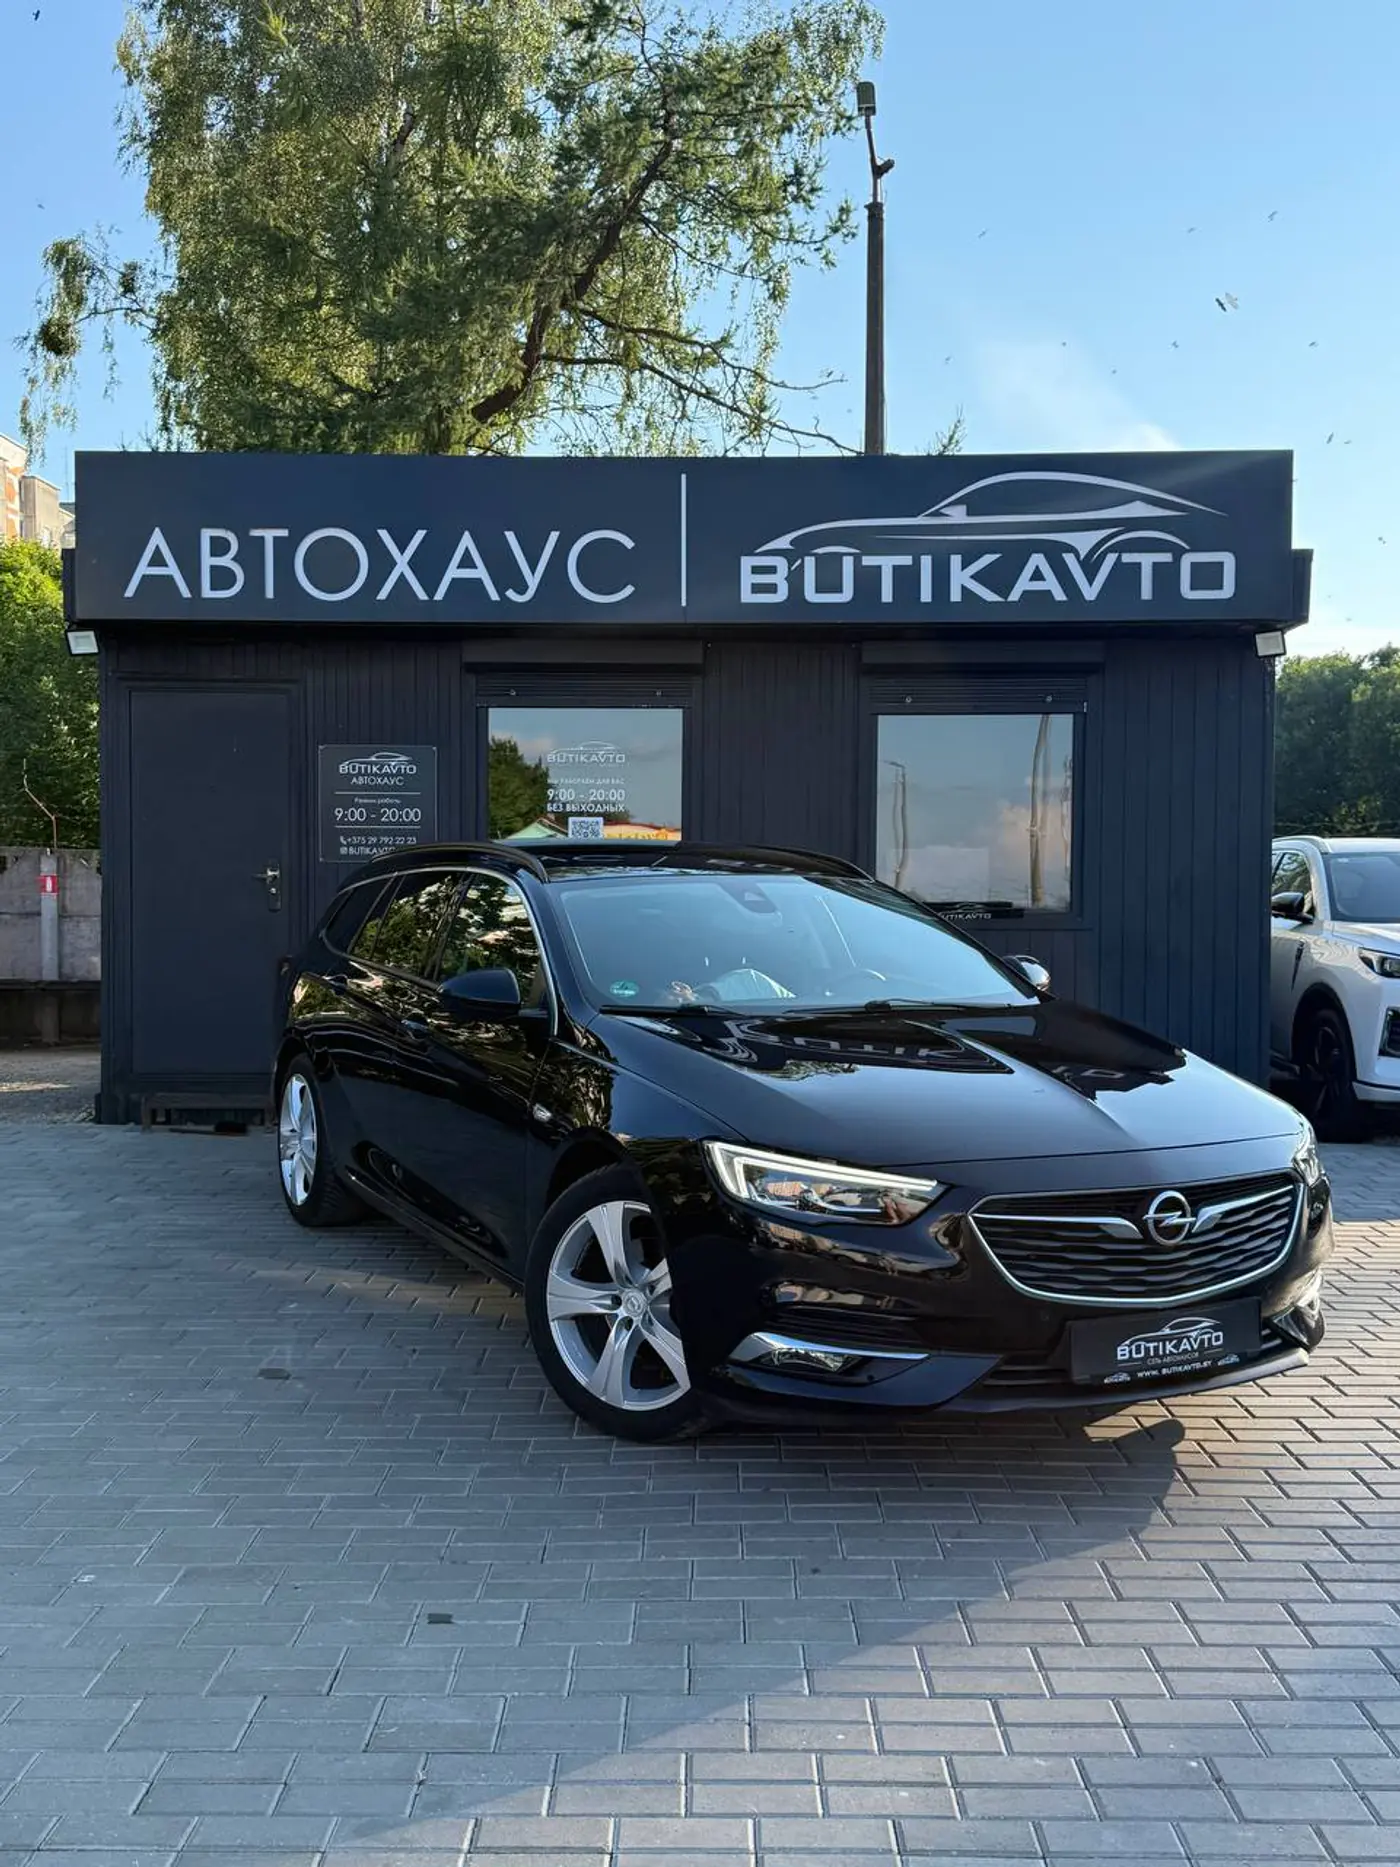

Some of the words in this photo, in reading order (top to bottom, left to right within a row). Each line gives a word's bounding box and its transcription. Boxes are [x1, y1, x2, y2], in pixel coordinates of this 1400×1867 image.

[124, 526, 636, 604] АВТОХАУС
[740, 549, 1236, 604] BUTIKAVTO
[547, 752, 625, 763] BUTIKAVTO
[339, 763, 417, 775] BUTIKAVTO
[350, 776, 405, 785] АВТОХАУС
[547, 788, 576, 801] 9:00
[589, 788, 625, 801] 20:00
[547, 803, 564, 812] БЕЗ
[566, 803, 625, 812] ВЫХОДНЫХ
[334, 807, 367, 821] 9:00
[380, 807, 421, 821] 20:00
[940, 912, 992, 920] UTIKAVTO
[1116, 1331, 1223, 1360] BUTIKAVTO
